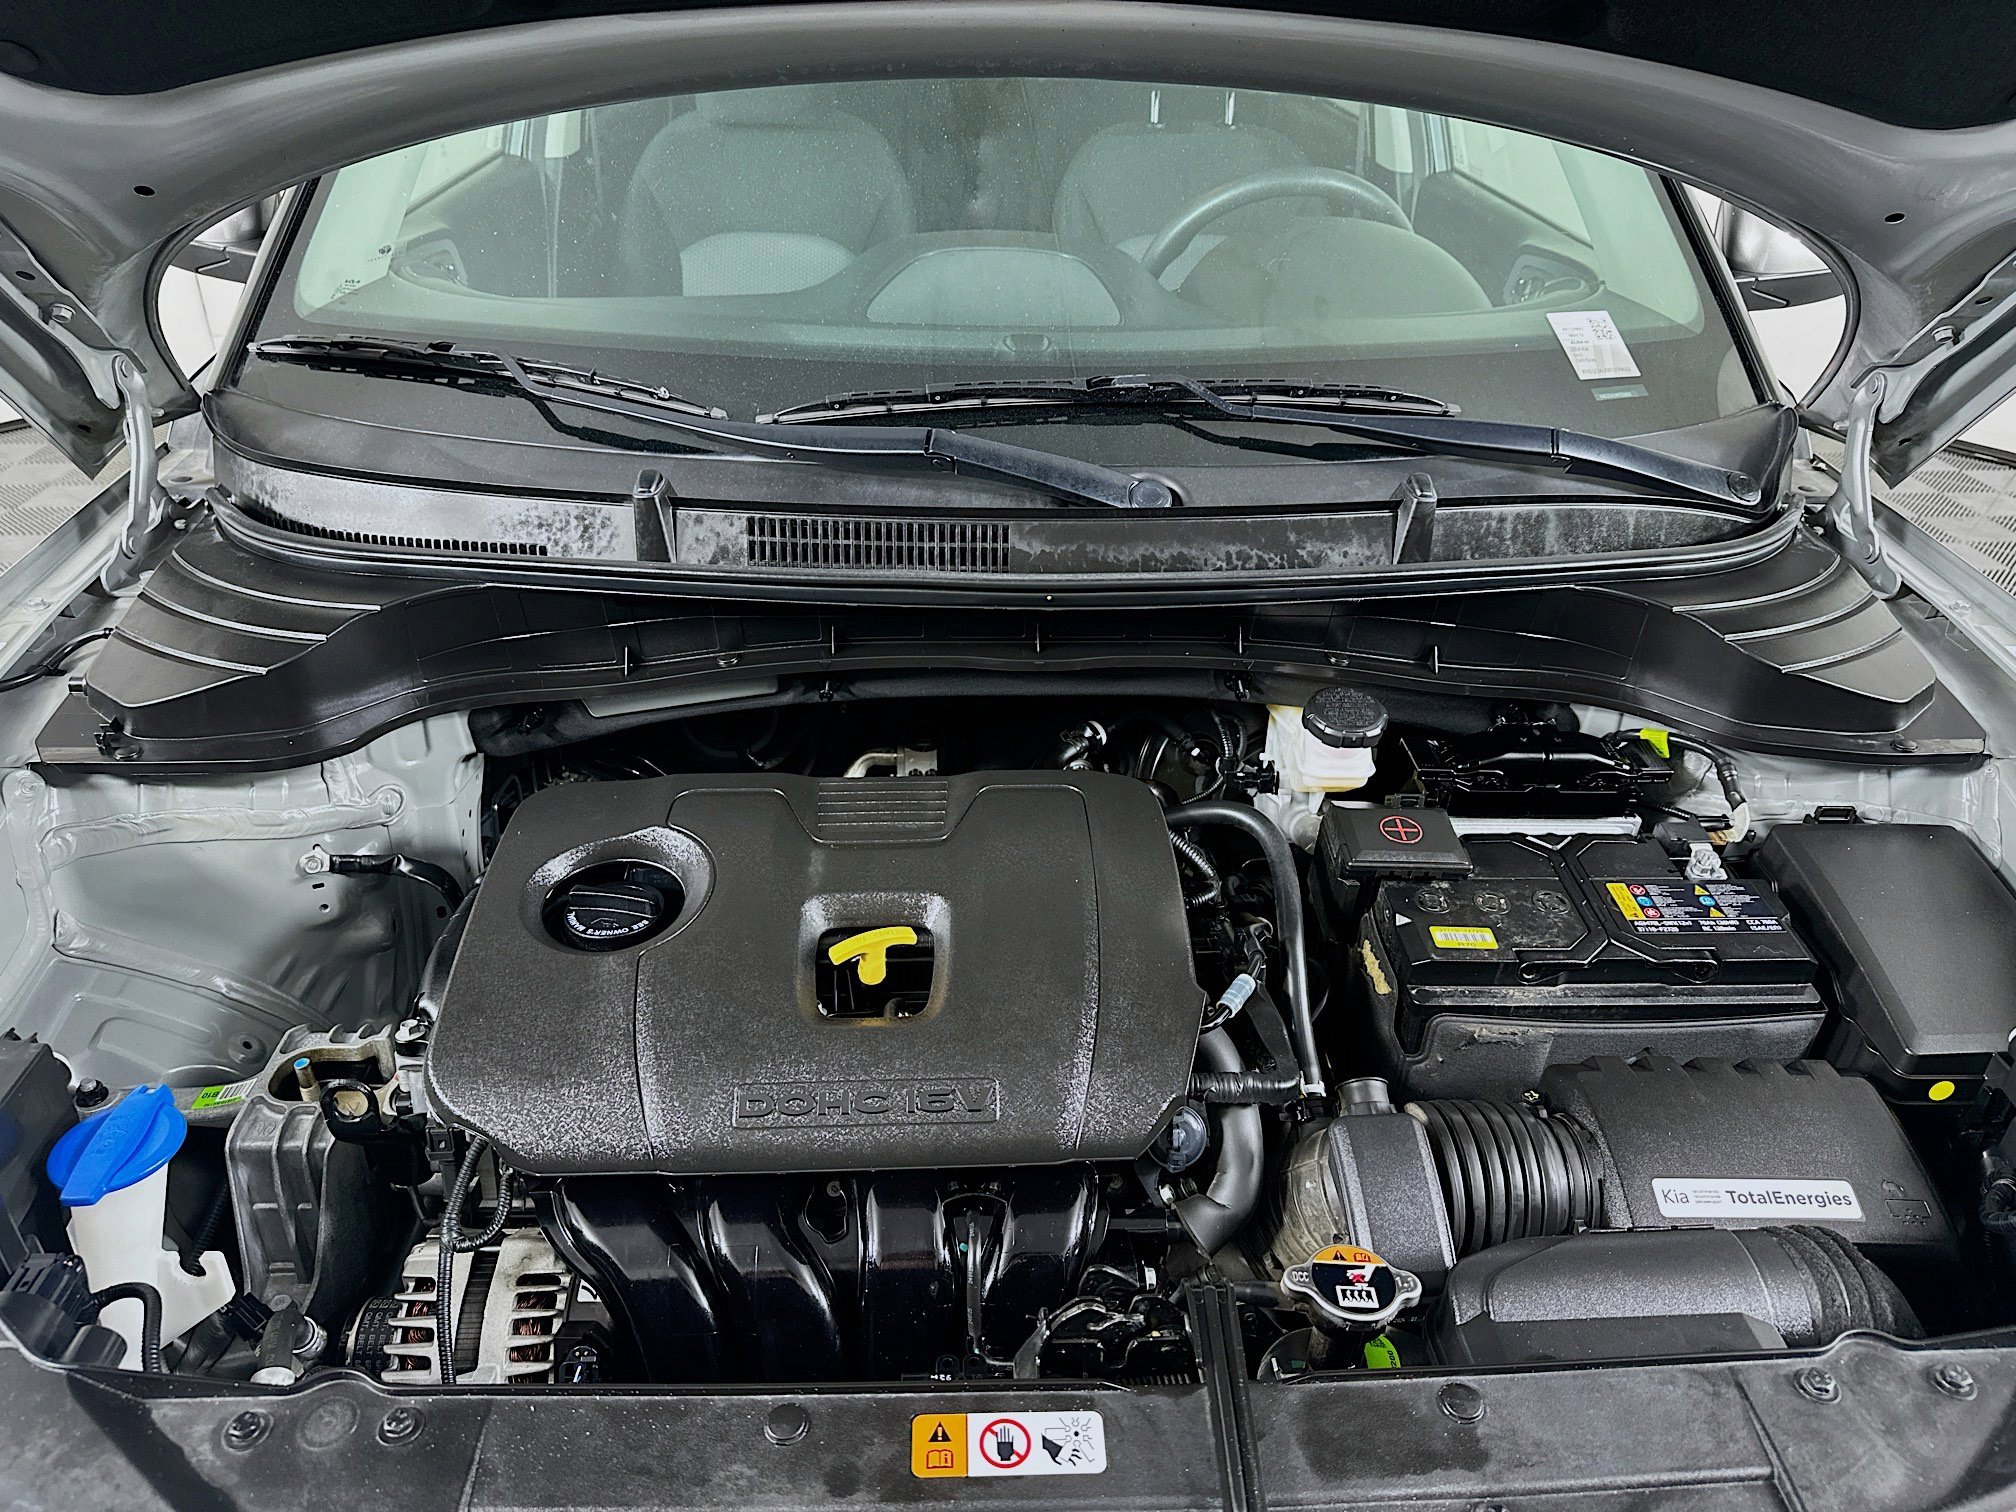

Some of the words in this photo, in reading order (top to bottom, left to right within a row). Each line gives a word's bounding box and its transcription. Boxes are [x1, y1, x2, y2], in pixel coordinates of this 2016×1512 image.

[631, 919, 650, 930] SEE
[586, 927, 629, 936] OWNER'S
[738, 1090, 890, 1118] DOHC
[905, 1087, 994, 1114] 16V
[1661, 1188, 1690, 1204] Kia
[1725, 1189, 1852, 1208] TotalEnergies
[1291, 1271, 1310, 1282] DCC
